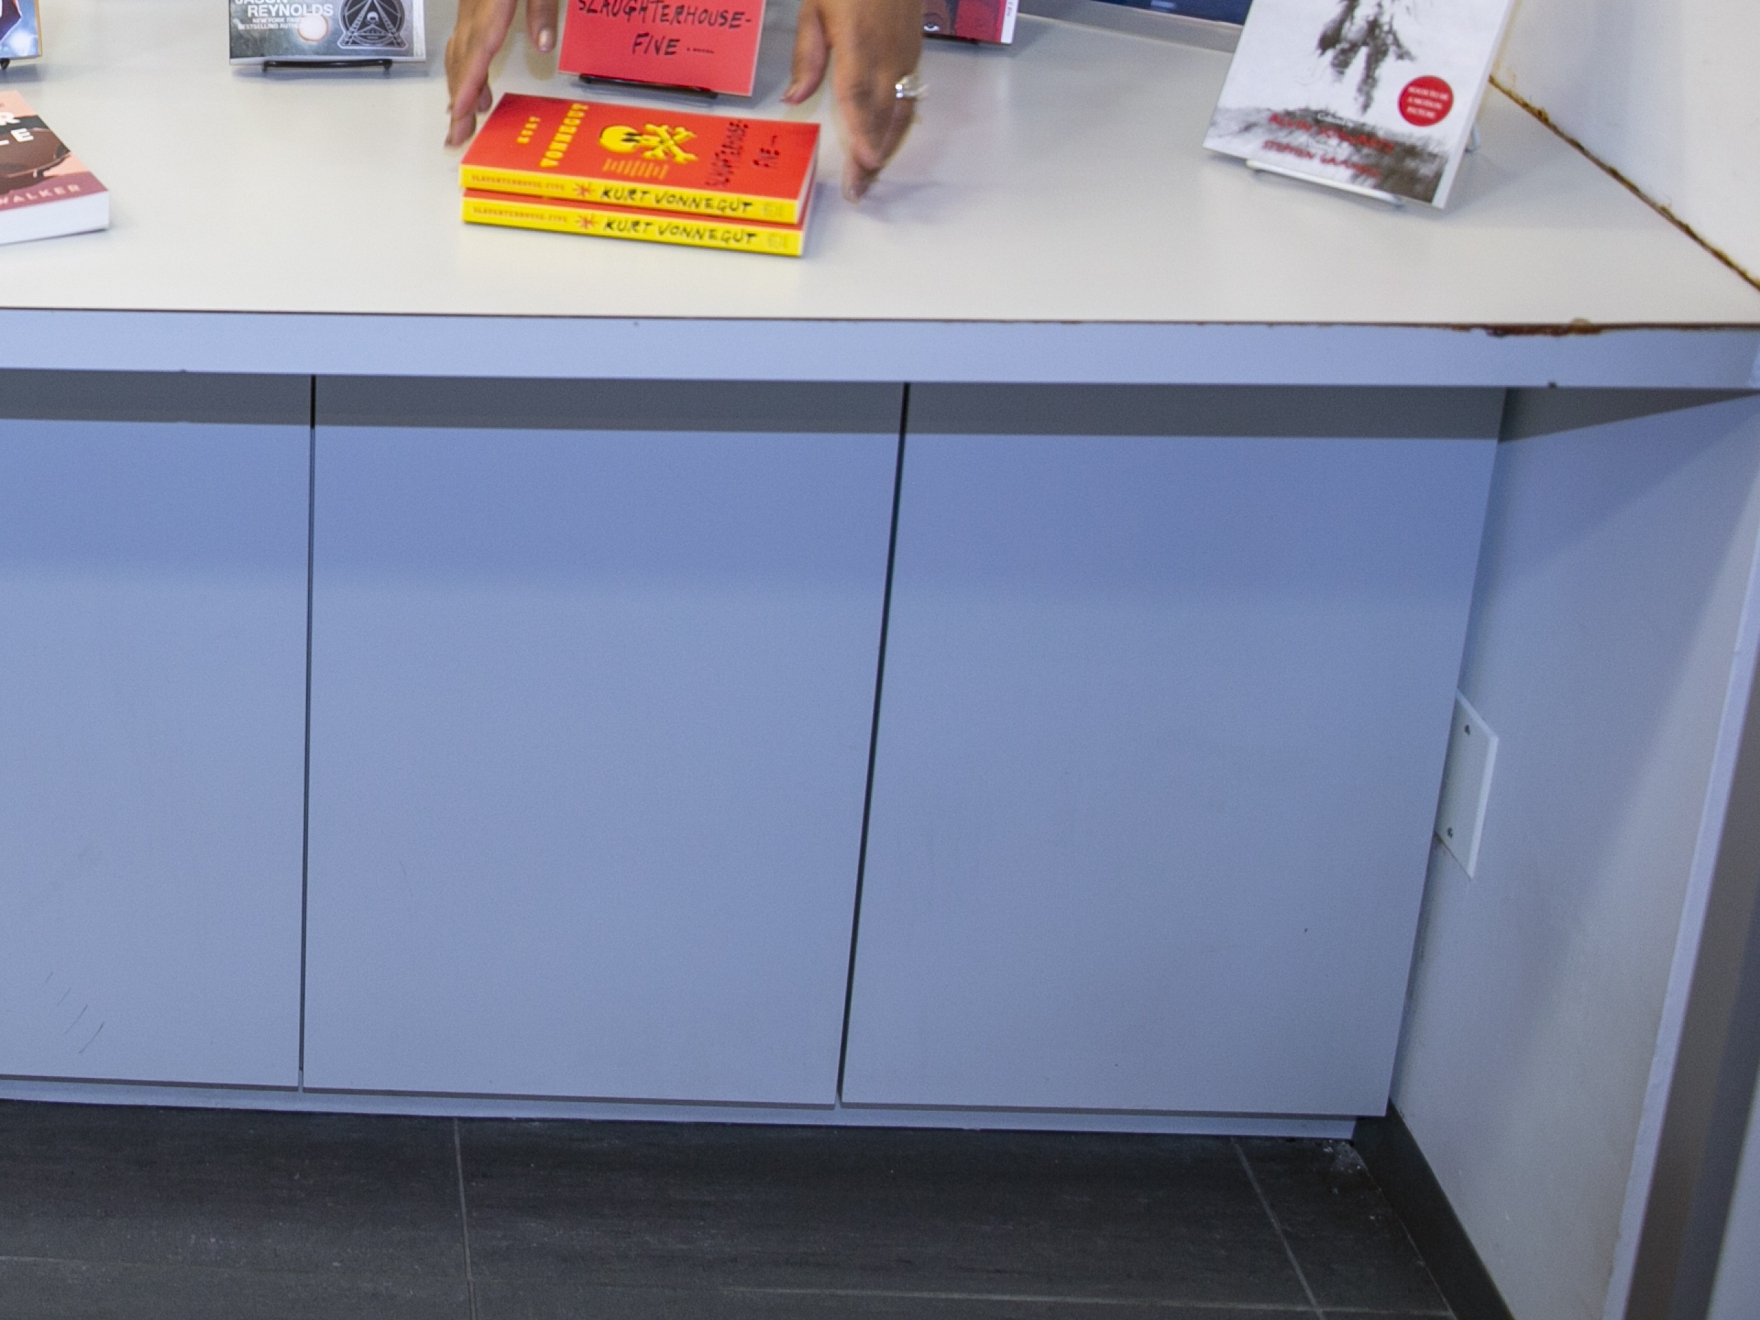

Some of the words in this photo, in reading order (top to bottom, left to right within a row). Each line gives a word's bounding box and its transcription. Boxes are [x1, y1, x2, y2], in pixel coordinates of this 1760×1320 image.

[247, 3, 333, 17] REYNOLDS
[632, 32, 681, 56] FIVE
[601, 186, 650, 201] KURT
[654, 191, 753, 212] VONNEGUT
[604, 217, 653, 233] KURT
[658, 222, 757, 243] VONNEGUT
